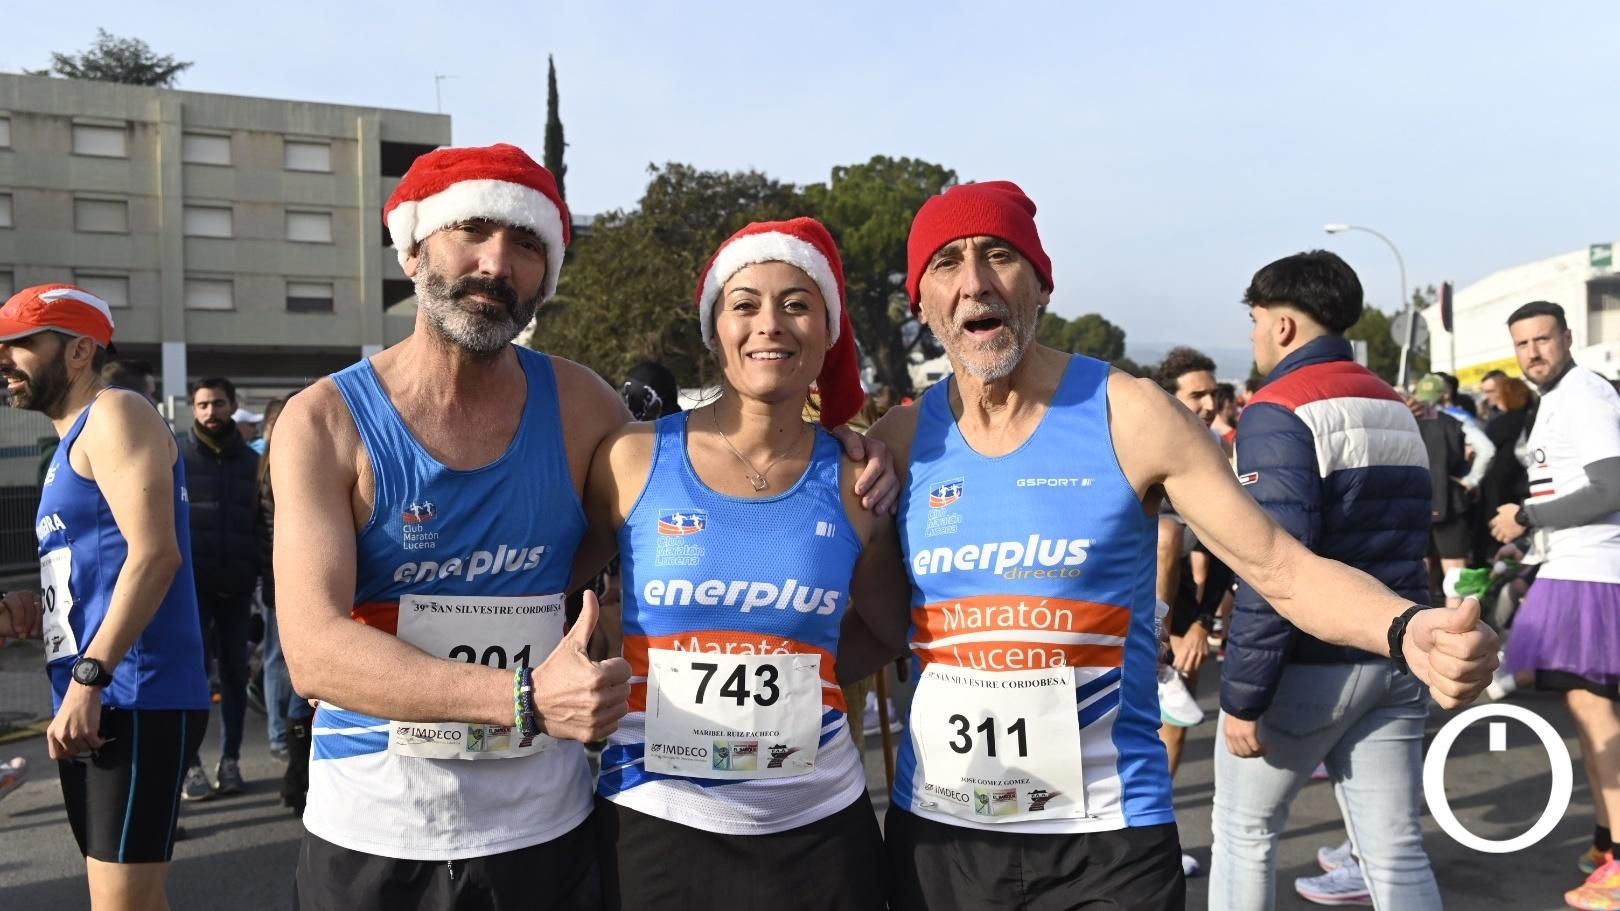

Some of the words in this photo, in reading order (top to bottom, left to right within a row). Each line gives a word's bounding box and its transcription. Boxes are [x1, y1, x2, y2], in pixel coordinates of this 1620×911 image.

[1016, 478, 1079, 487] GSPORT
[403, 524, 423, 533] Club
[403, 532, 439, 541] Maratón
[403, 541, 436, 550] Lucena
[912, 534, 1090, 576] enerplus
[1003, 566, 1081, 580] directo
[643, 578, 840, 615] enerplus
[431, 604, 453, 613] SAN
[455, 605, 514, 615] SILVESTRE
[515, 604, 561, 615] CORDOBESA
[942, 599, 1073, 632] Maratón
[691, 662, 780, 706] 743
[1001, 677, 1066, 688] CORDOBESA
[411, 727, 462, 741] IMDECO
[693, 728, 725, 737] MARIBEL
[745, 730, 780, 738] PACHECO
[948, 713, 1028, 757] 311
[663, 743, 708, 758] IMDECO
[935, 785, 970, 803] IMDECO
